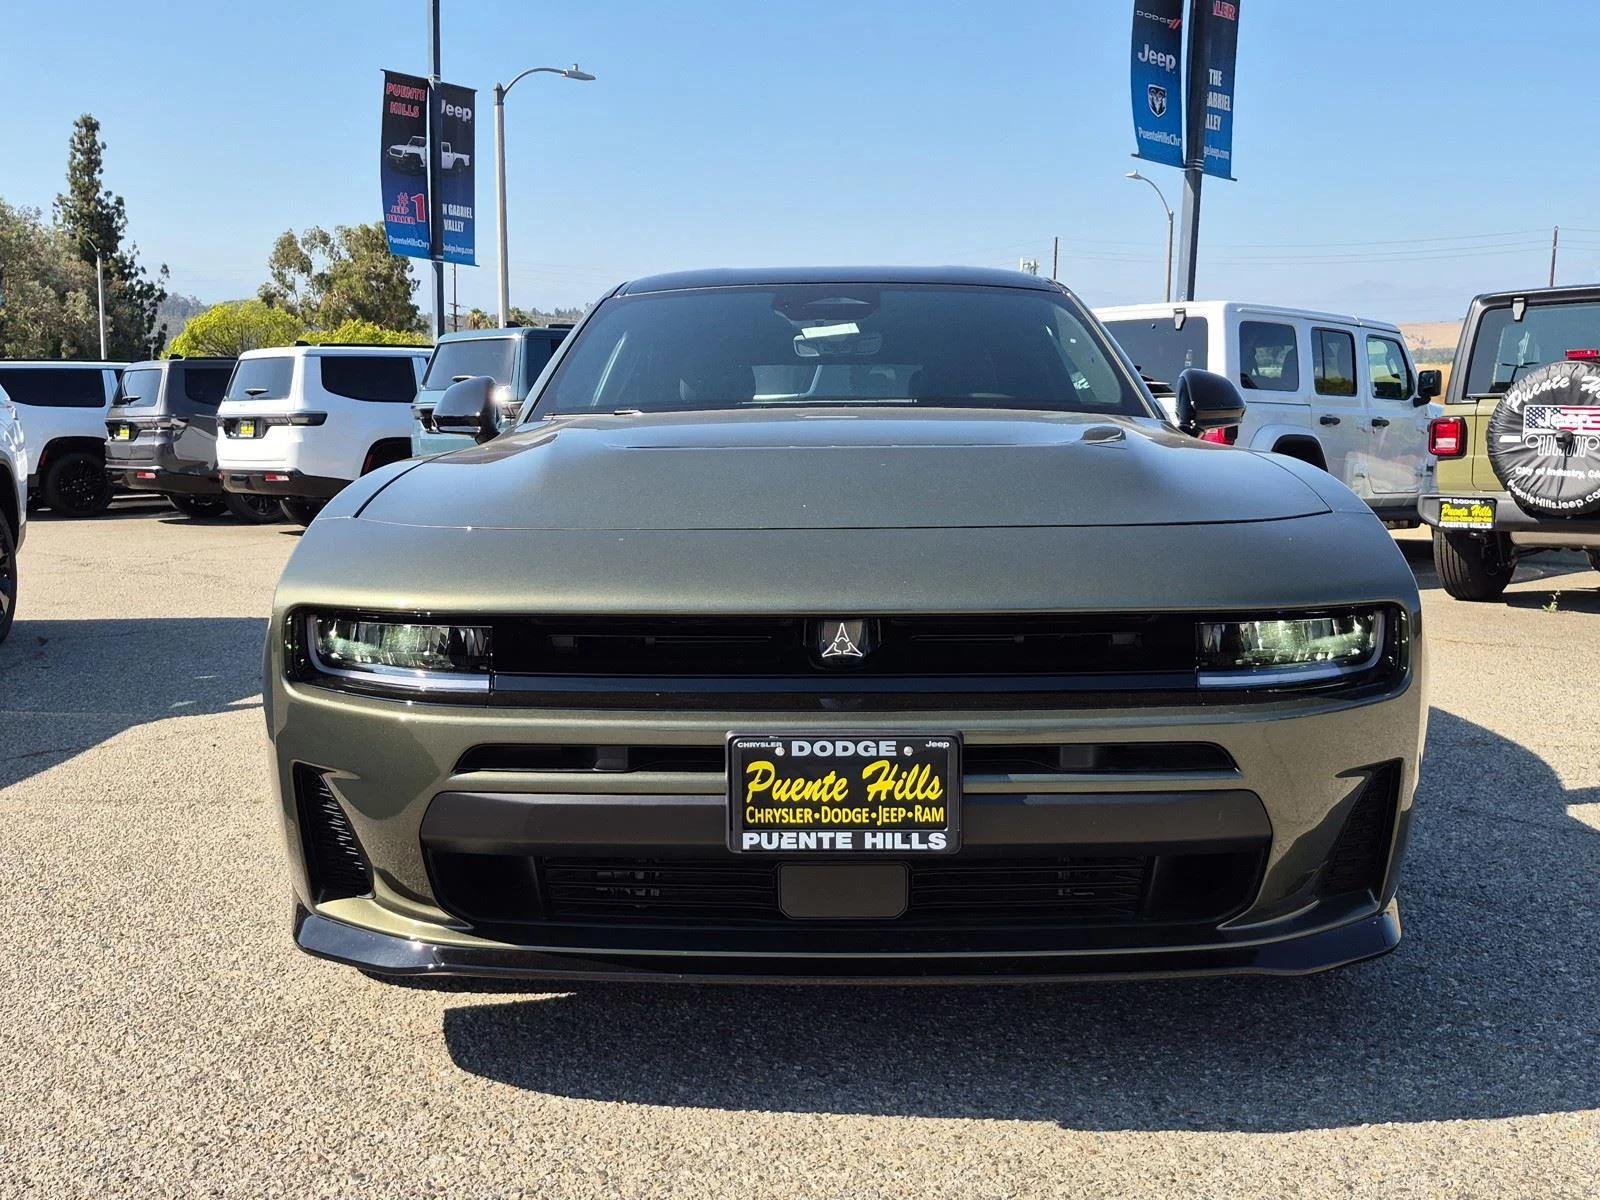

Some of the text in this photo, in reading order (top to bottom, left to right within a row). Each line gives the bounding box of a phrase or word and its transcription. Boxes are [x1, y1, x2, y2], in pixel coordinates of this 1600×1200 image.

[1136, 10, 1173, 25] DODGE
[1138, 43, 1176, 72] Jeep
[1208, 68, 1223, 87] THE
[386, 82, 426, 102] PUENTE
[1206, 91, 1231, 112] ABRIEL
[390, 101, 420, 118] HILLS
[441, 99, 472, 122] Jeep
[448, 204, 473, 219] GABRIEL
[443, 219, 465, 233] VALLEY
[1506, 374, 1570, 414] Puente
[1536, 407, 1592, 434] Jeep
[1515, 466, 1534, 477] City
[1535, 467, 1545, 475] of
[737, 740, 950, 757] CHRYSLER DODGE Jeep
[746, 759, 944, 803] Puente Hills
[742, 832, 947, 850] PUENTE HILLS
